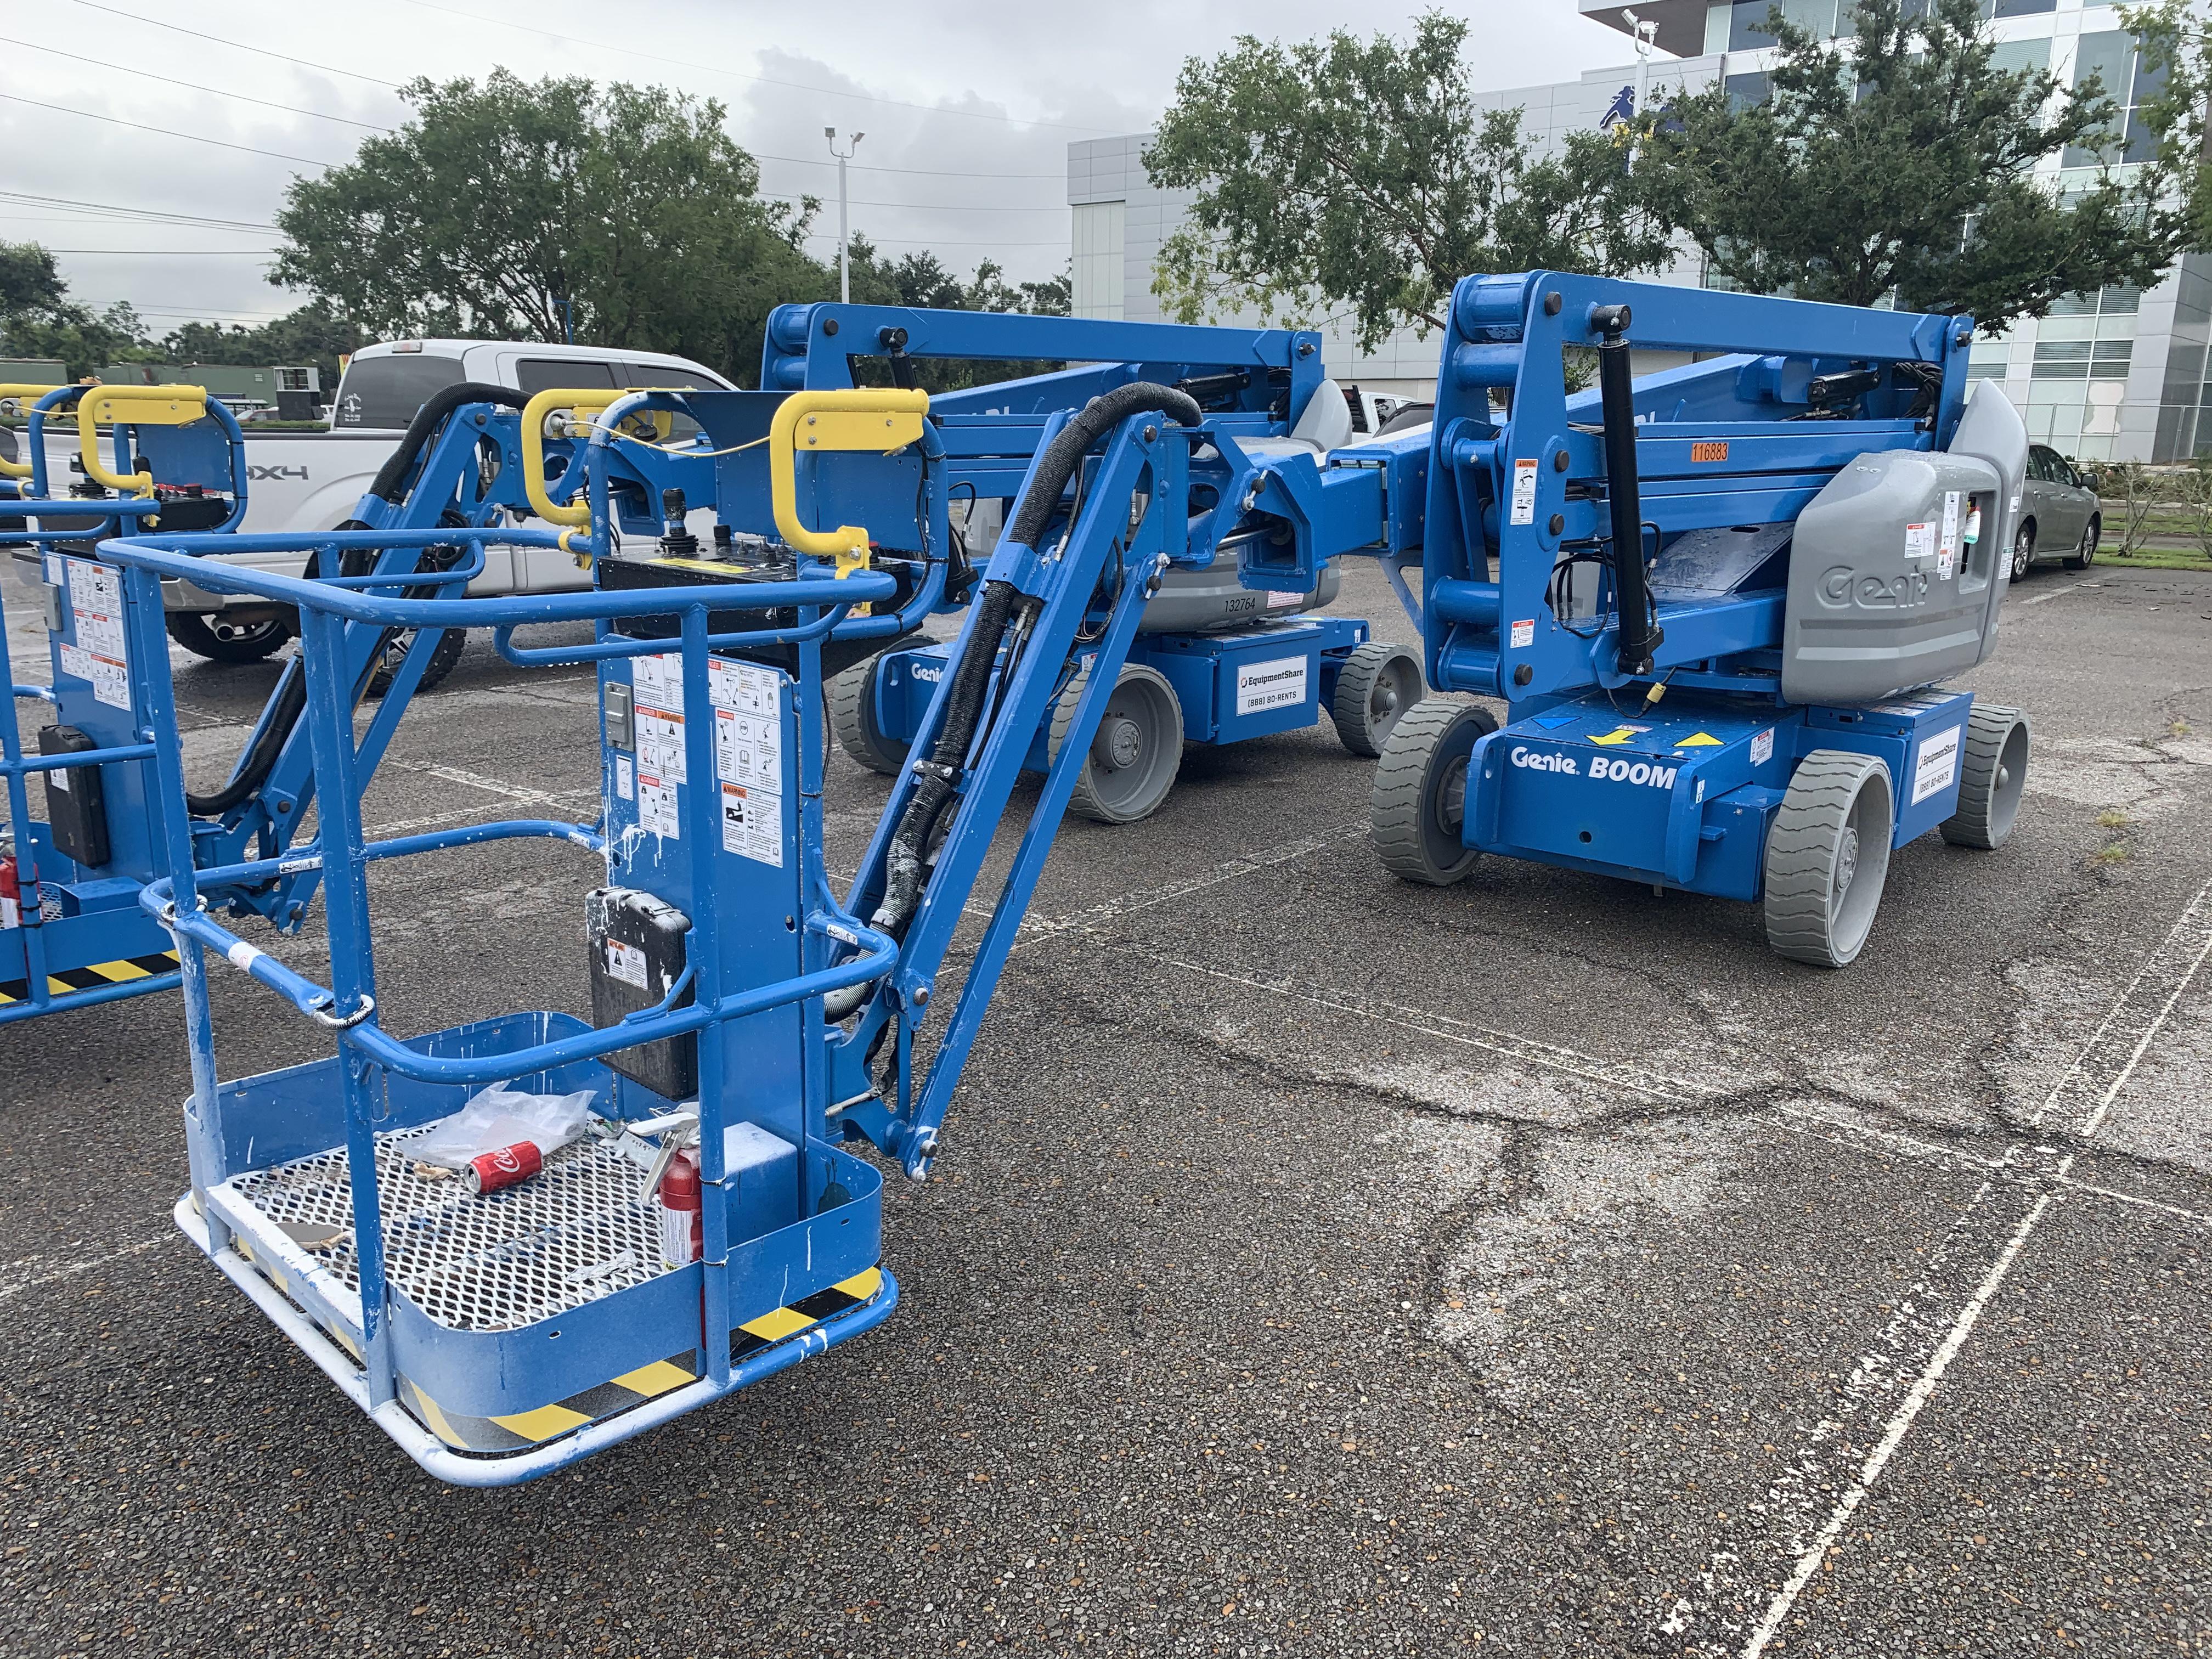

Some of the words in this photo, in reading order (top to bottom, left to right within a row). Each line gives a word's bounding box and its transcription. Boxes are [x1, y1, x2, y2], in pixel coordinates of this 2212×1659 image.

[1694, 443, 1727, 461] 116883
[1225, 597, 1255, 612] 132764
[1248, 670, 1304, 686] EquipmentShare
[1248, 697, 1265, 708] (888)
[1267, 691, 1296, 703] 80-RENTS
[1923, 743, 1956, 766] EquipmentShare
[1588, 757, 1678, 789] BOOM
[727, 786, 746, 797] WARNING
